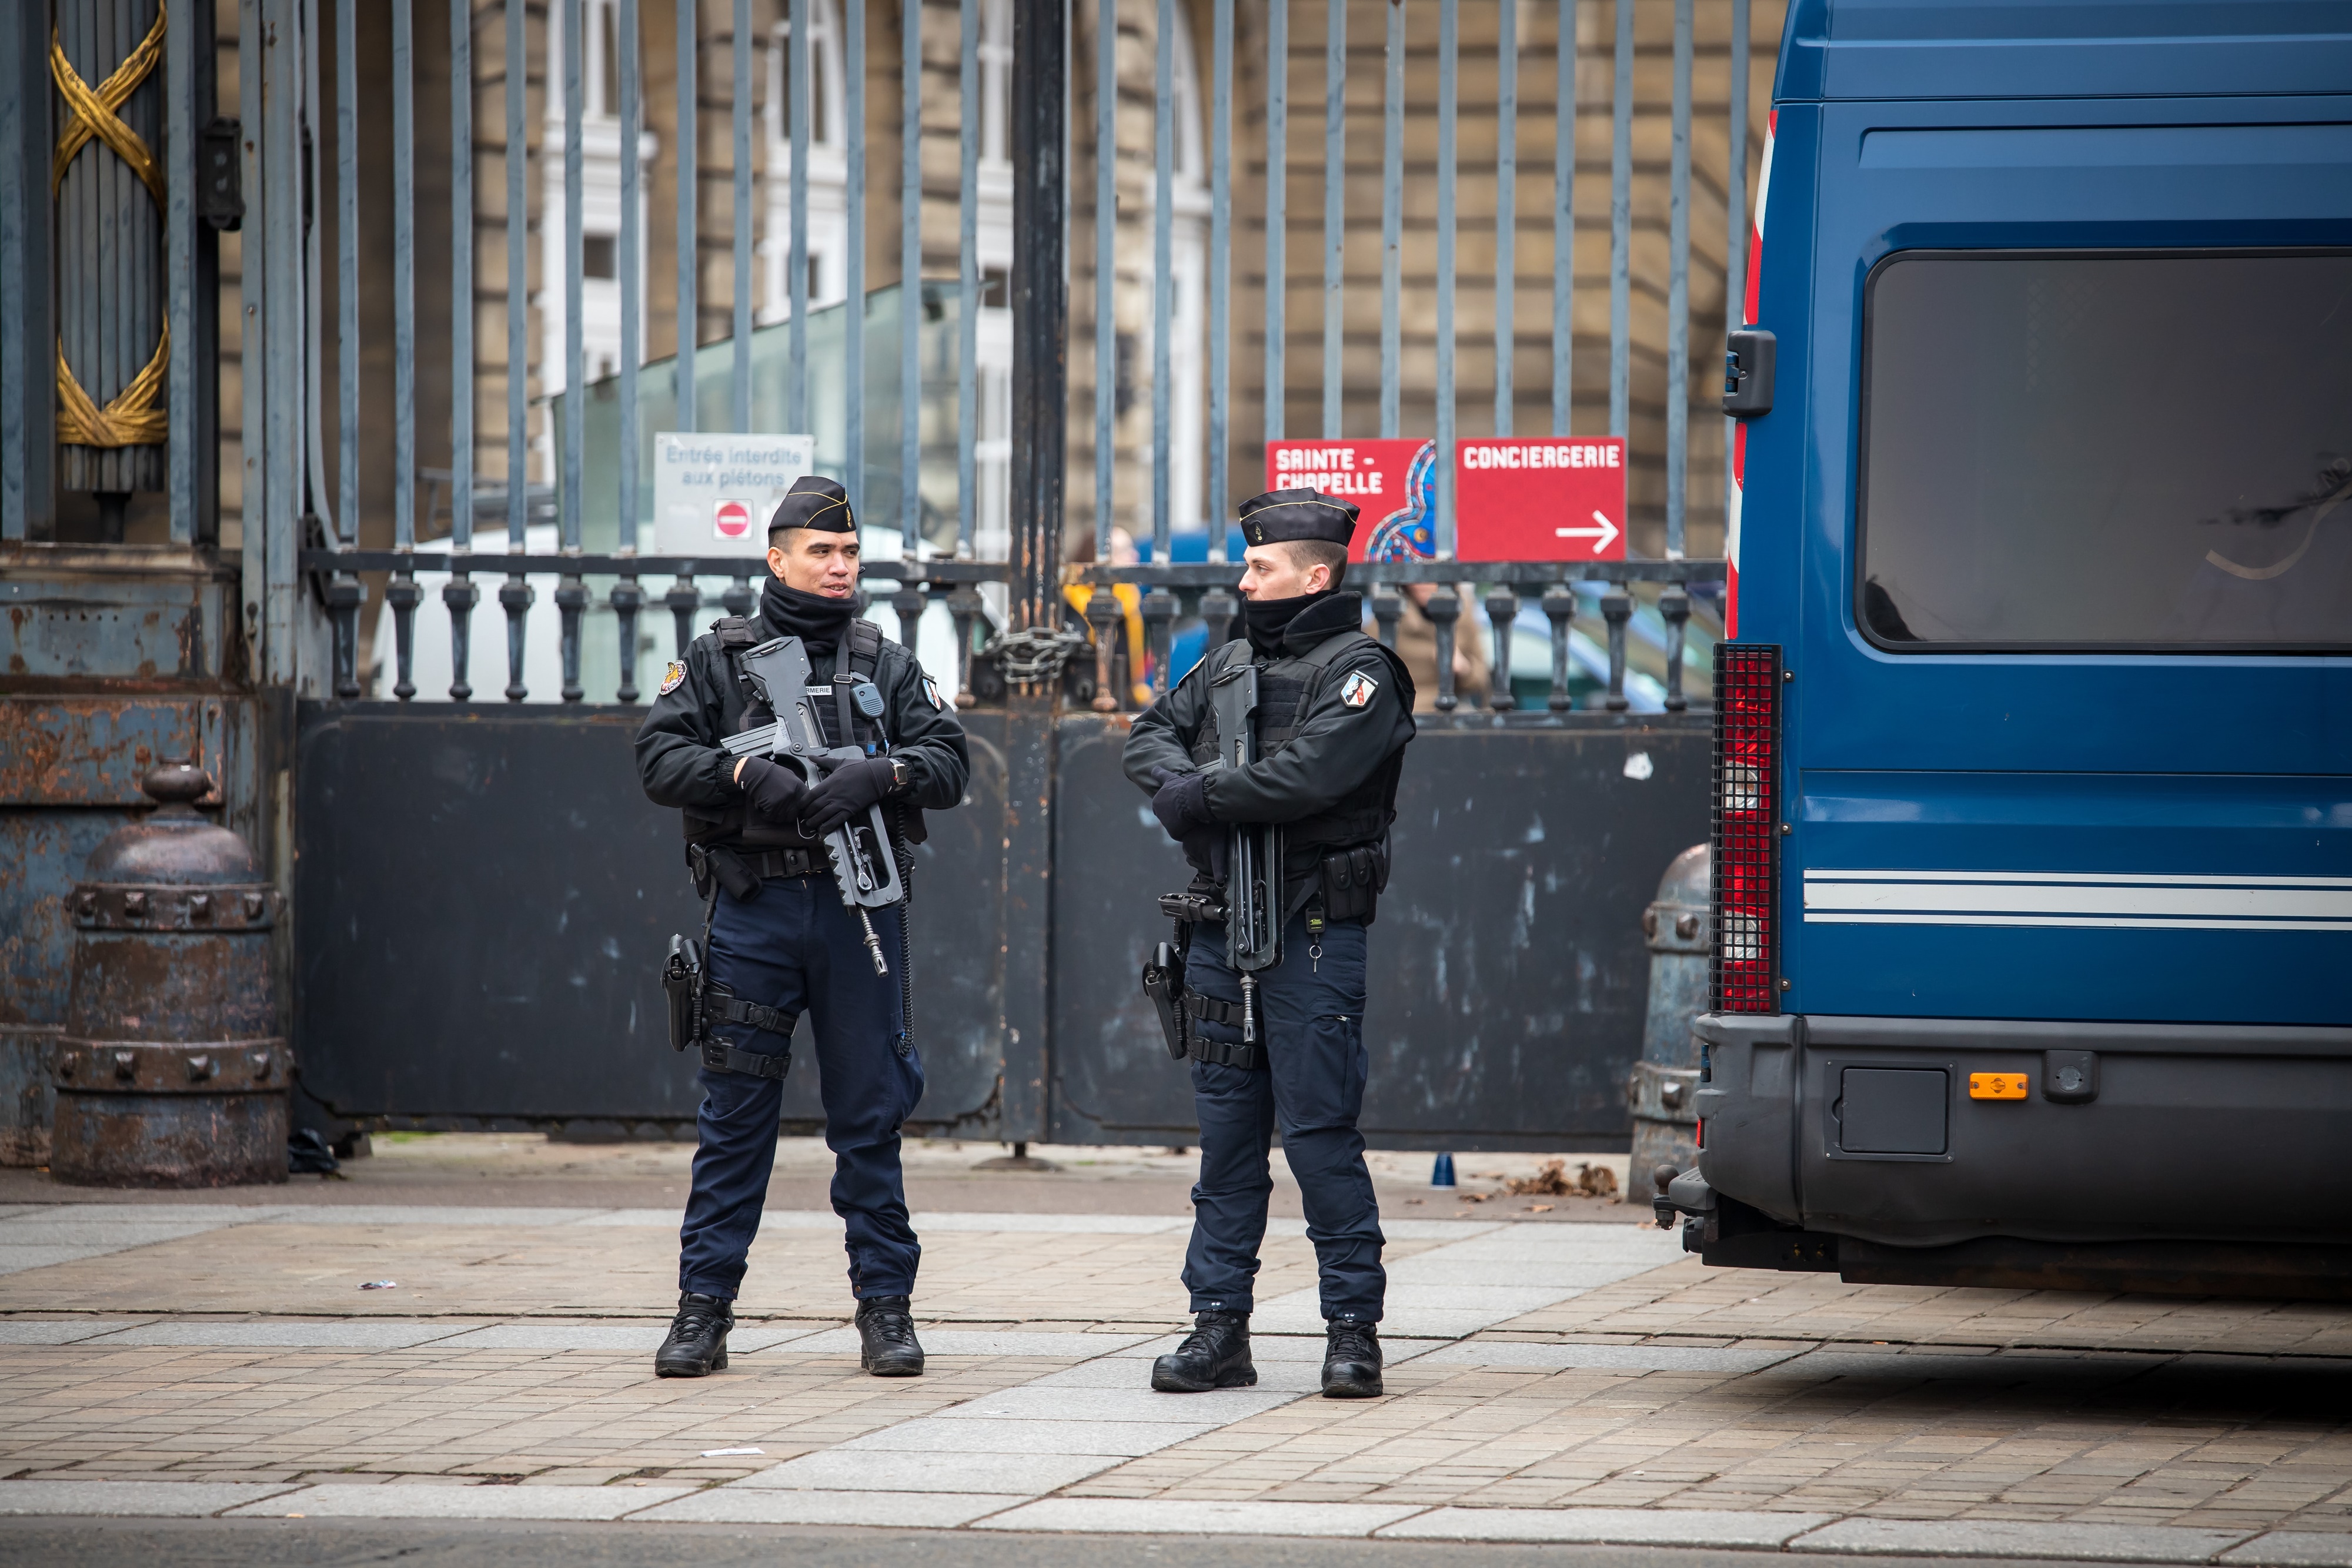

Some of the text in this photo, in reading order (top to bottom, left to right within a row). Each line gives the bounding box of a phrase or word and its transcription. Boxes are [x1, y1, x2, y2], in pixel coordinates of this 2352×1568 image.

[666, 445, 801, 464] Entrée interdite
[1276, 448, 1355, 470] SAINTE
[1464, 444, 1620, 469] CONCIERGERIE
[682, 468, 785, 490] aux piétons
[1276, 472, 1383, 494] CHAPELLE
